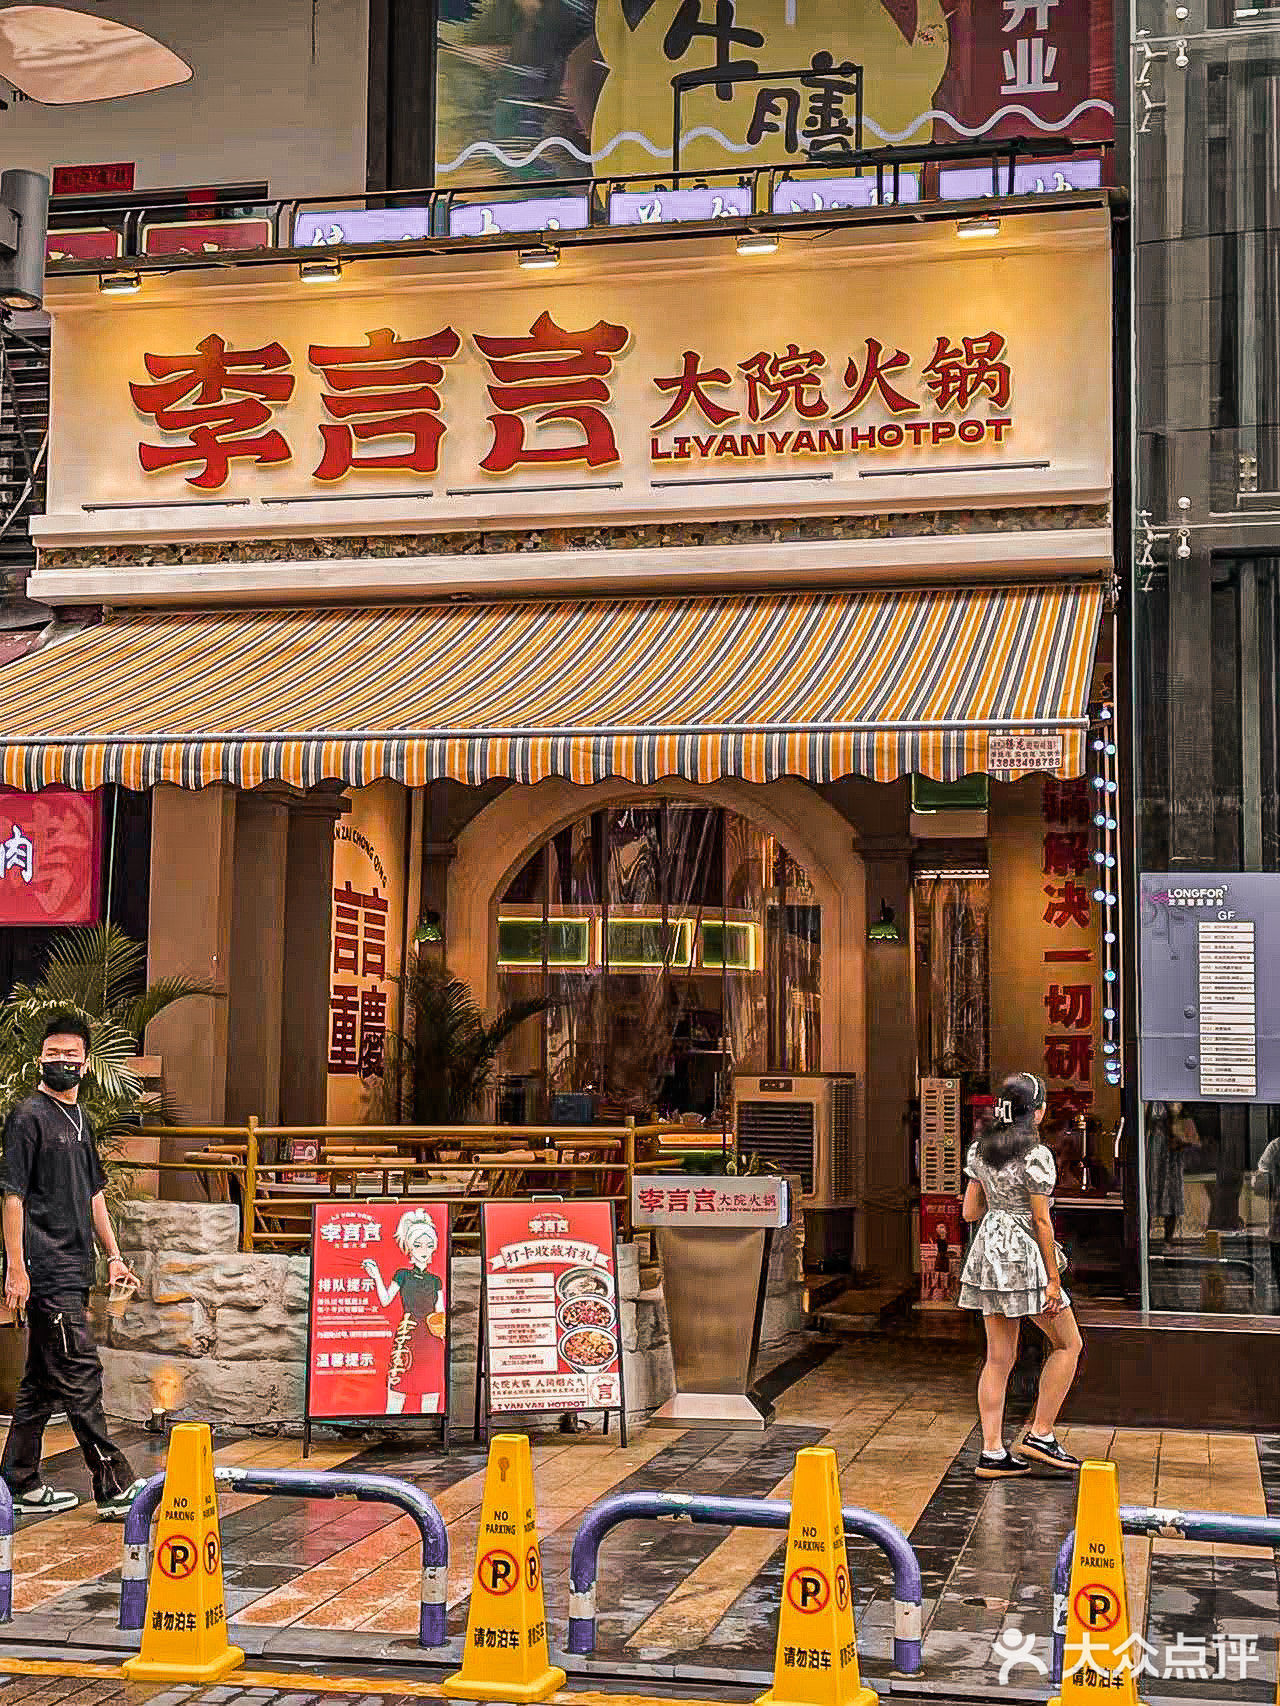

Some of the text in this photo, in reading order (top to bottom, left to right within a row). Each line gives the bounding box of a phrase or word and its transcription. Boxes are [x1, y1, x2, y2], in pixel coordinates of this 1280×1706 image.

[649, 330, 1013, 430] 大院火锅
[651, 418, 1013, 461] LIYANYAN HOTPOT
[1168, 888, 1223, 899] LONGFOR
[1217, 911, 1236, 920] GF
[719, 1193, 776, 1207] 大院火锅
[505, 1245, 594, 1264] 打卡收藏有礼
[318, 1278, 375, 1293] 排队提示
[547, 1399, 587, 1409] HOTPOT
[173, 1498, 188, 1508] NO
[165, 1511, 195, 1521] PARKING
[493, 1511, 509, 1521] NO
[486, 1523, 516, 1535] PARKING
[802, 1526, 817, 1537] NO
[793, 1540, 826, 1552] PARKING
[1088, 1543, 1106, 1554] NO
[1080, 1556, 1115, 1569] PARKING
[152, 1611, 197, 1632] 请勿泊车
[473, 1627, 520, 1650] 请勿泊车
[784, 1646, 832, 1670] 请勿泊车
